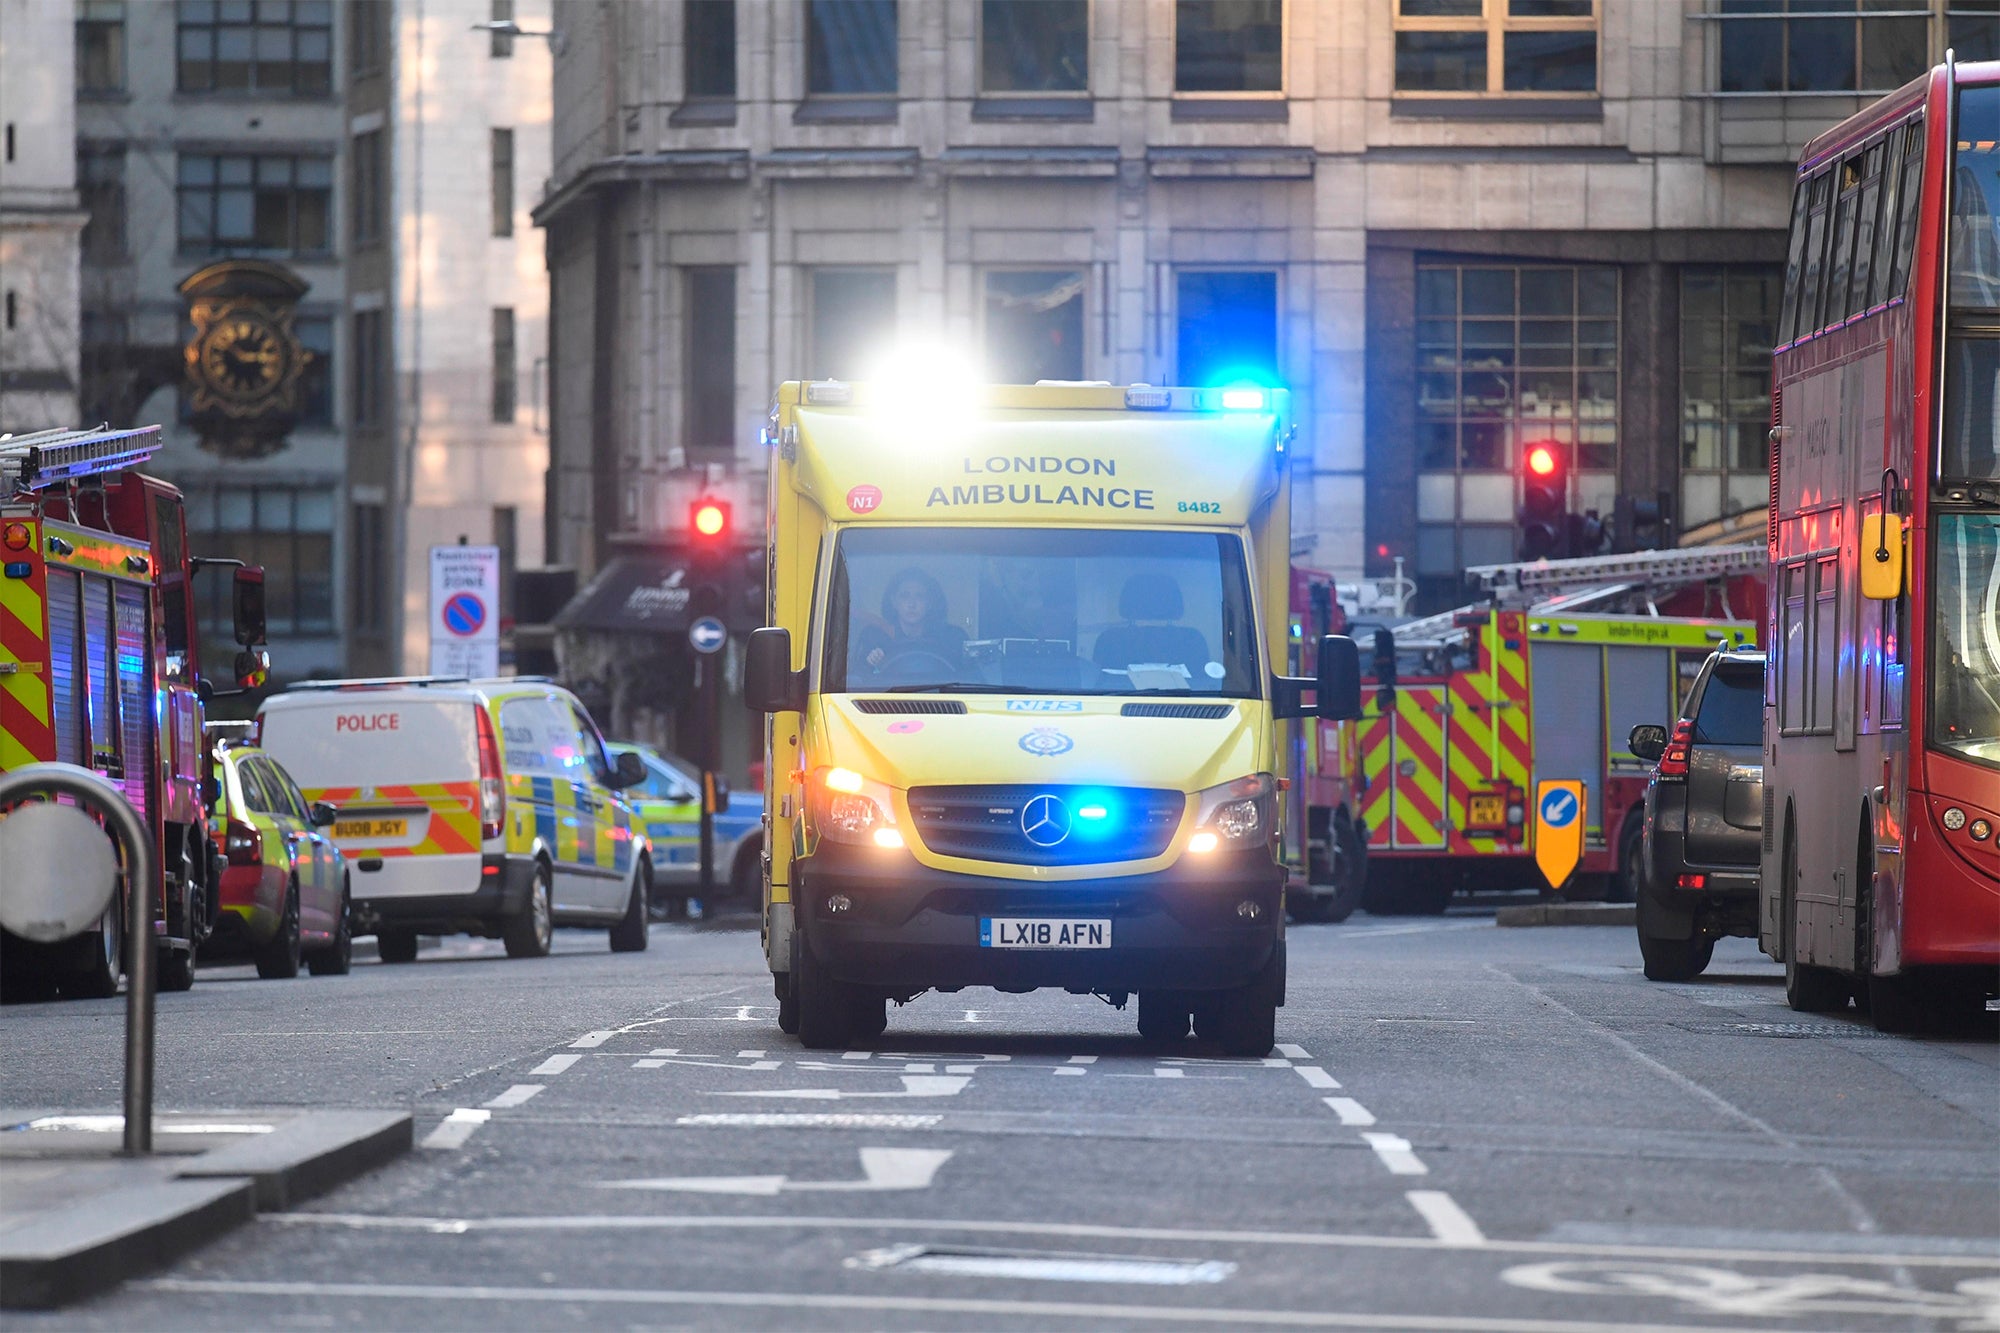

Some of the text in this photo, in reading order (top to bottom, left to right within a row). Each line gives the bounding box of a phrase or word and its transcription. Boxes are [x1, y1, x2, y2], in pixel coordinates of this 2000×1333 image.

[964, 456, 1116, 476] LONDON
[853, 496, 873, 509] N1
[926, 484, 1155, 510] AMBULANCE
[1177, 501, 1222, 514] 8482
[1008, 700, 1079, 711] NHS
[336, 713, 399, 732] POLICE
[335, 819, 401, 835] BU08 JGY
[1000, 923, 1103, 944] LX18 AFN
